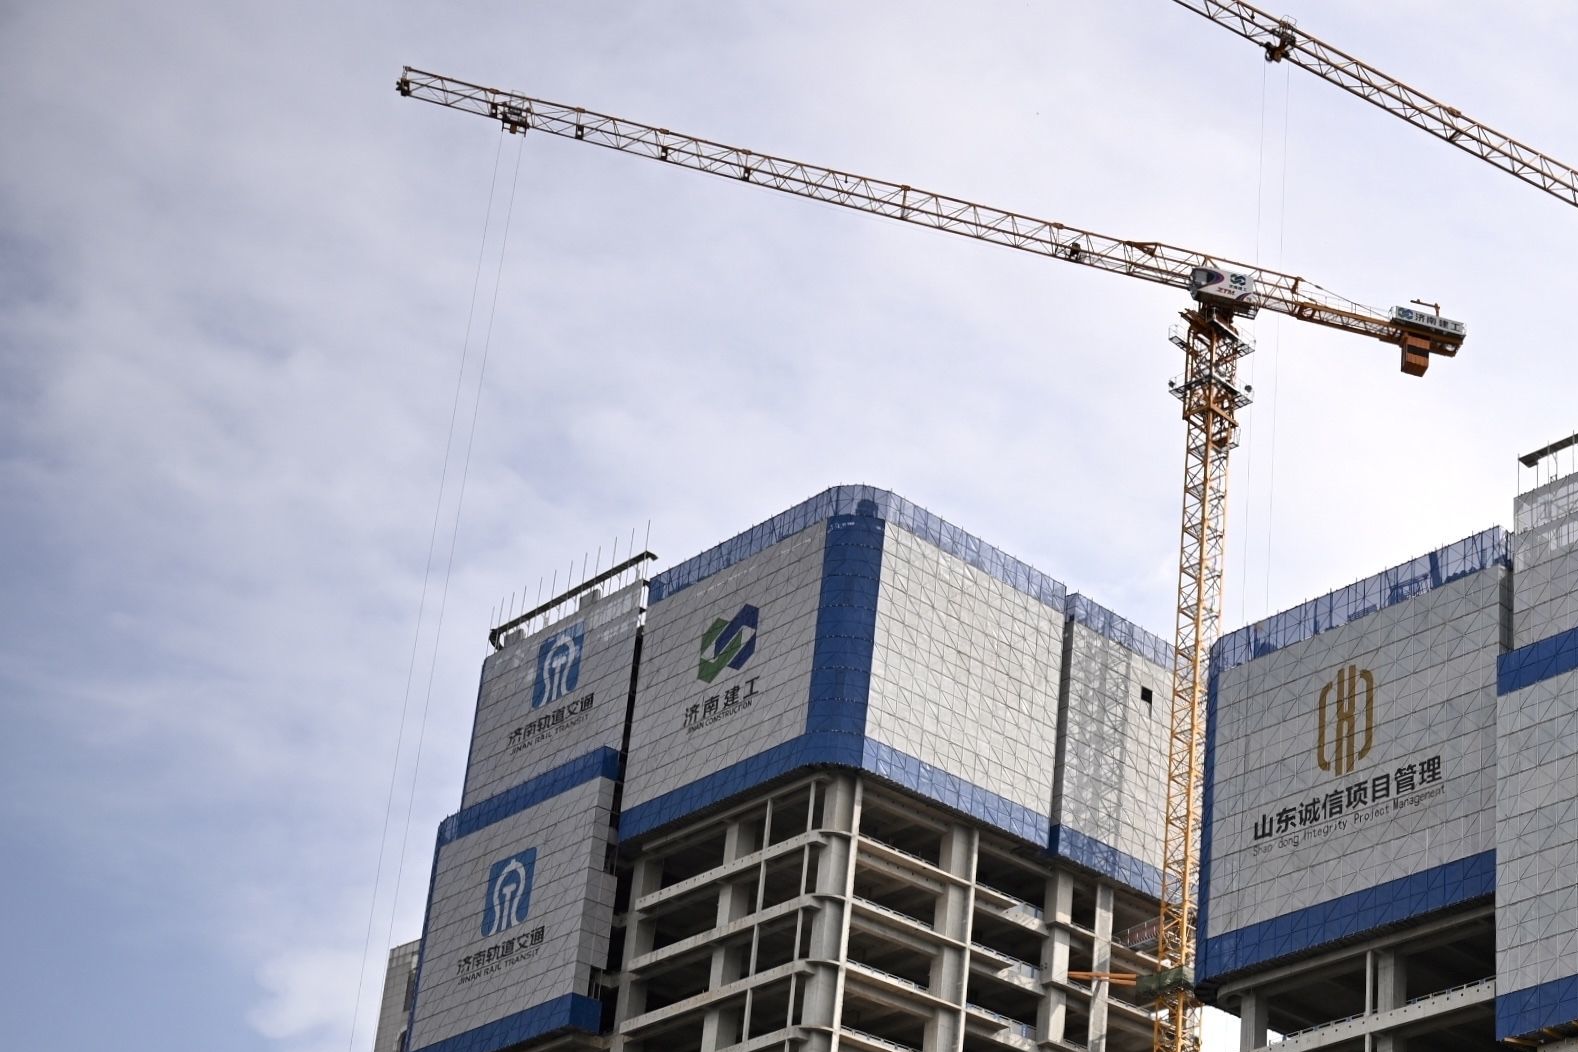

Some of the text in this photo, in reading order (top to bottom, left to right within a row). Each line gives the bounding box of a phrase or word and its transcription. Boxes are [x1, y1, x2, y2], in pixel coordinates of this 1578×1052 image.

[1415, 312, 1462, 333] 济南建工
[507, 692, 595, 746] 济南轨道交通
[683, 675, 760, 728] 济南建工
[510, 741, 533, 756] JINAN
[1253, 754, 1443, 841] 山东诚信项目管理
[1303, 818, 1348, 841] Integrity
[1353, 805, 1390, 825] Project
[456, 925, 545, 976] 济南轨道交通
[458, 947, 540, 986] JINAN RAIL TRANSIT
